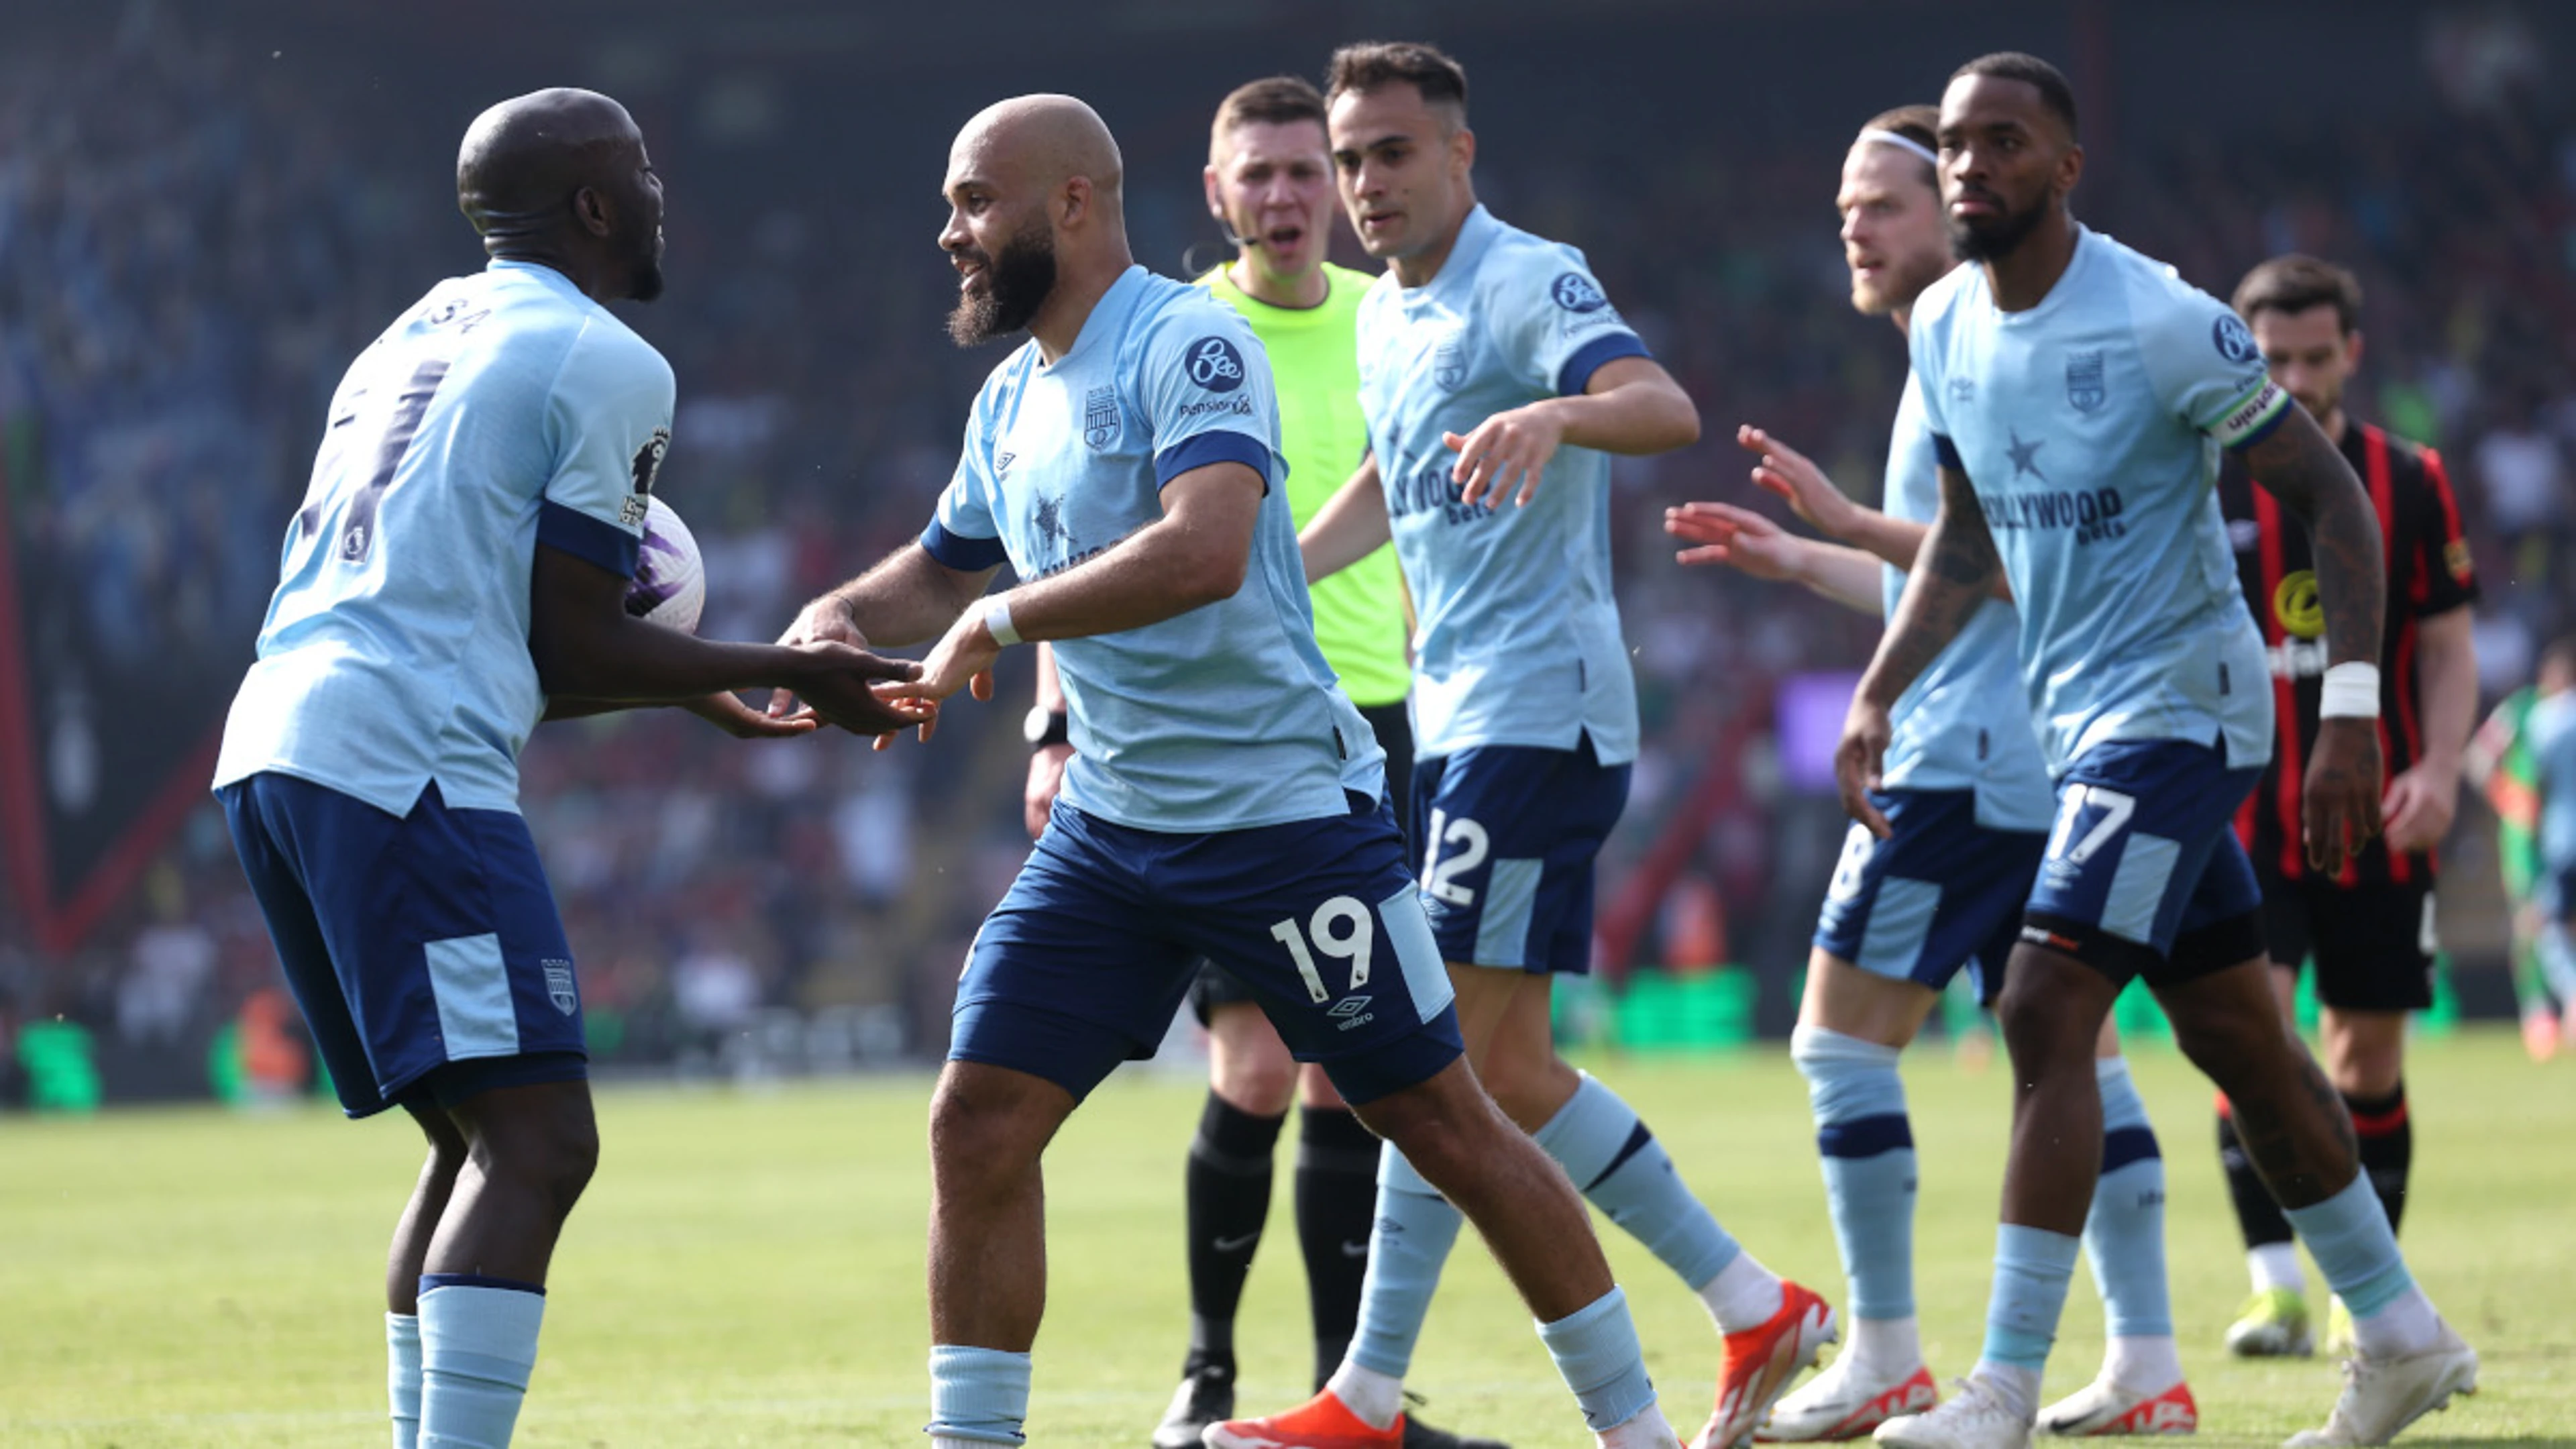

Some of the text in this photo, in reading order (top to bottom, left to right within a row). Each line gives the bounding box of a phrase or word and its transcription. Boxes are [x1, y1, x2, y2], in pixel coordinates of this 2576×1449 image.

[1420, 808, 1489, 906] 12
[2047, 783, 2136, 865] 17
[1270, 895, 1373, 1004] 19
[1337, 1012, 1374, 1031] umbro
